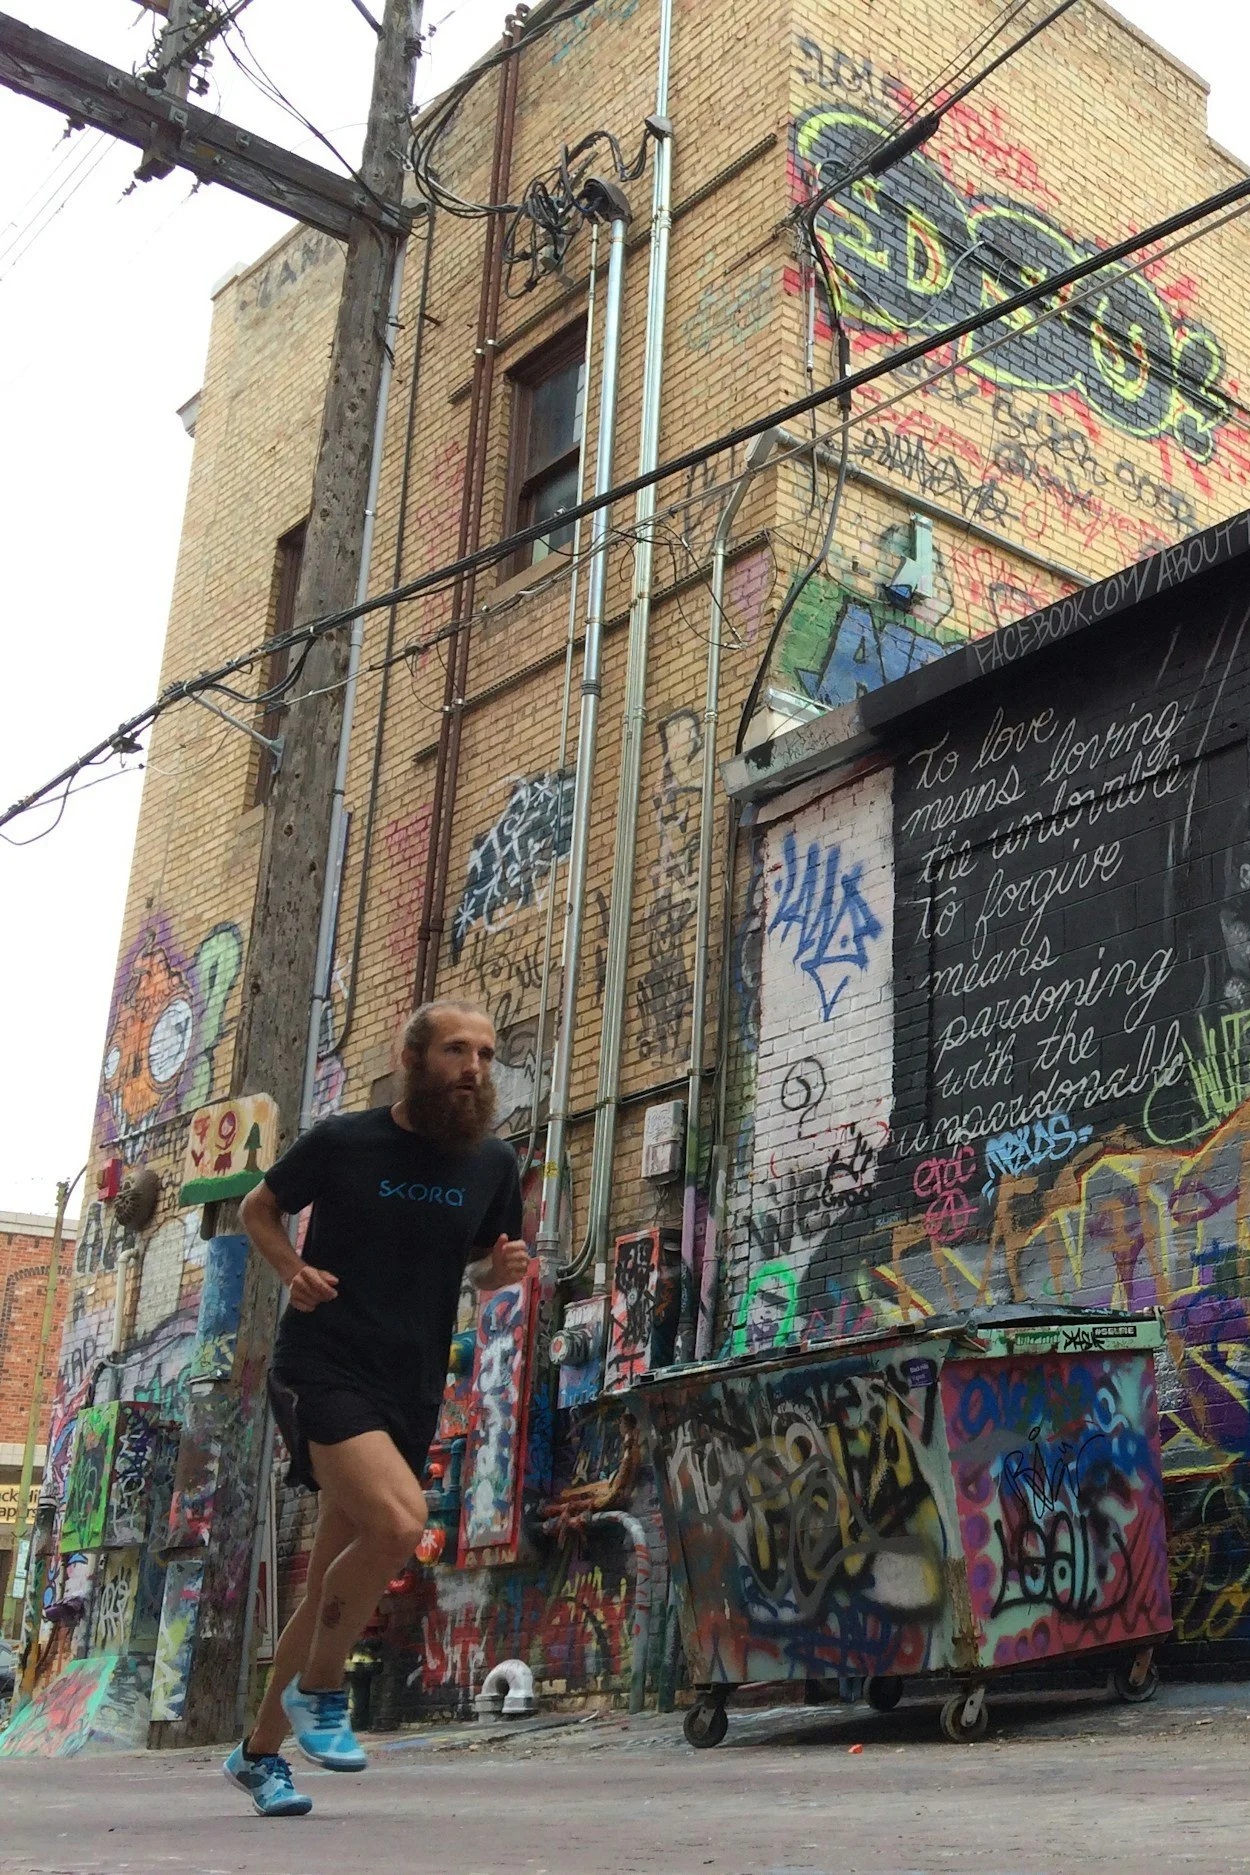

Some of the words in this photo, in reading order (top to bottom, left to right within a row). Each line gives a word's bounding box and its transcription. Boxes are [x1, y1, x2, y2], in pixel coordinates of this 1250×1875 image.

[901, 763, 1026, 838] means
[1040, 697, 1199, 788] loving
[907, 730, 959, 790] To
[971, 705, 1058, 774] love
[903, 889, 963, 944] To
[972, 837, 1126, 961] forgive
[916, 830, 977, 885] the
[918, 935, 1059, 999] means
[933, 947, 1179, 1072] pardoning
[936, 1033, 1015, 1102] with
[1031, 1008, 1097, 1071] the
